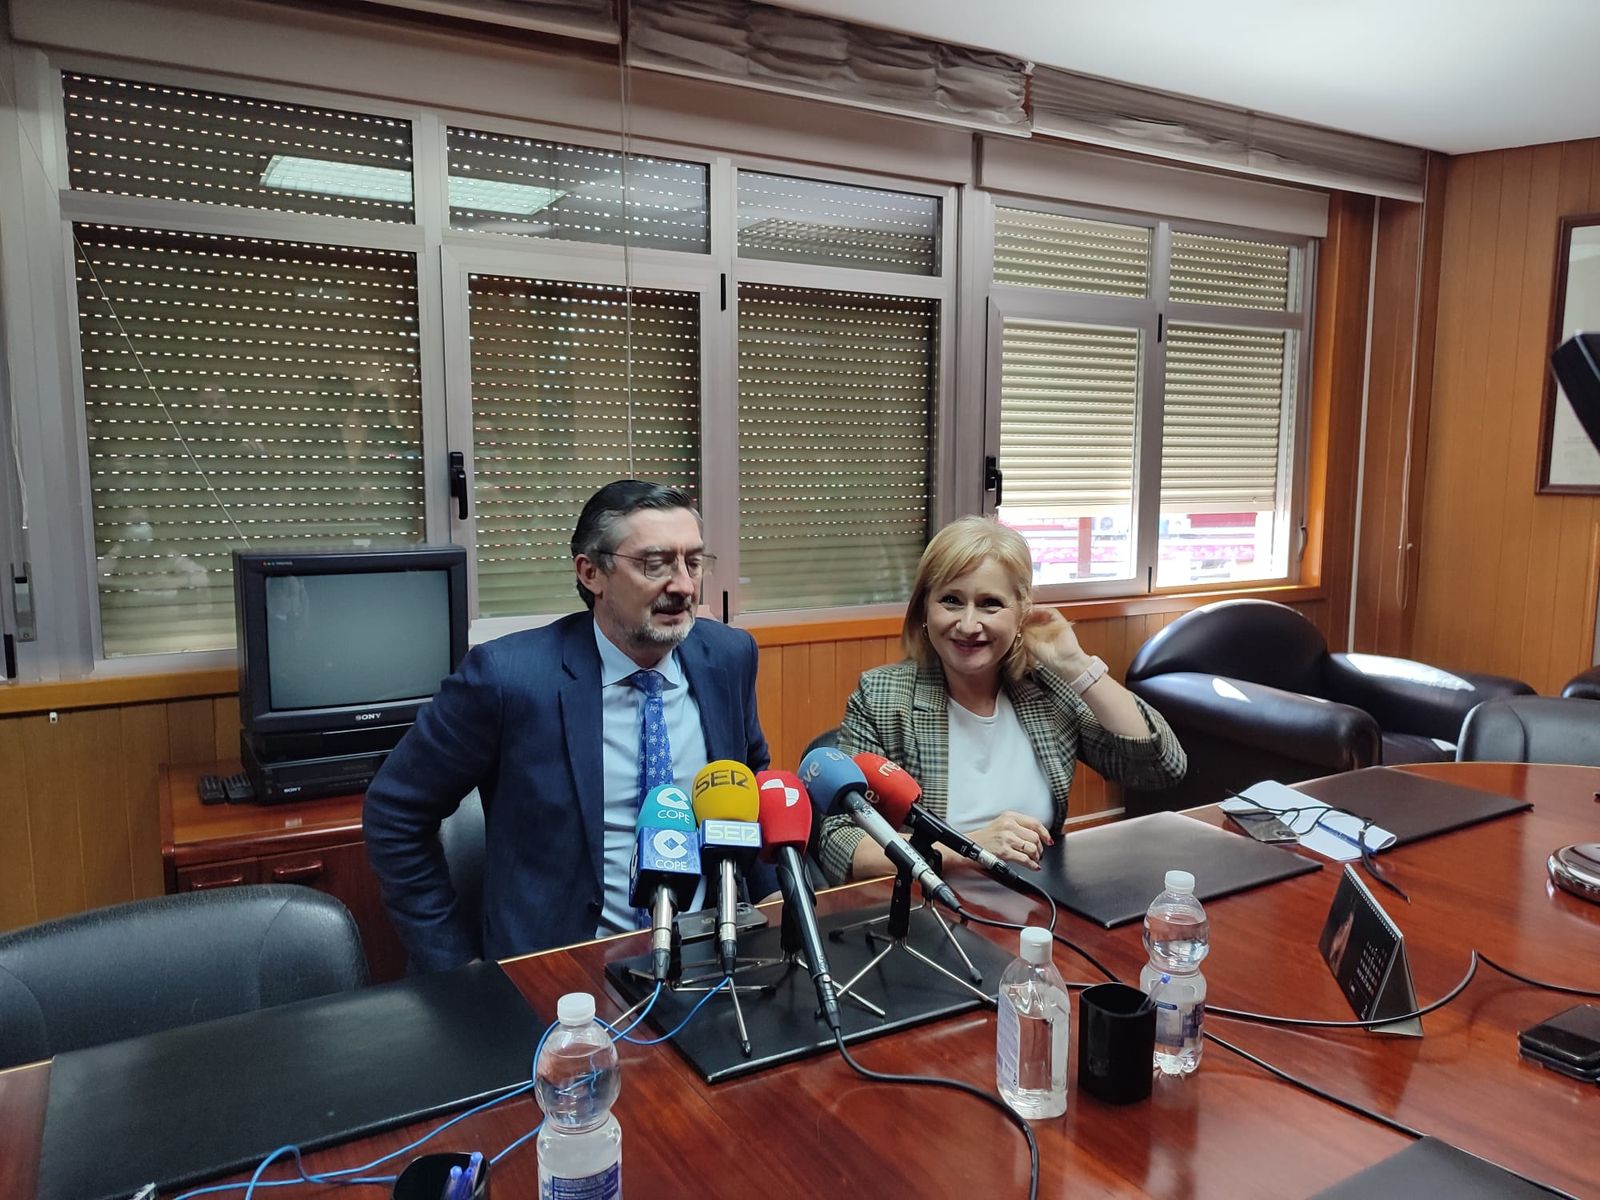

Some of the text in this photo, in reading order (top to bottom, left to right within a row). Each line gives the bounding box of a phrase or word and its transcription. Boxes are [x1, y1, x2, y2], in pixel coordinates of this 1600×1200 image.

[355, 712, 381, 721] SONY
[695, 769, 750, 798] SER
[657, 809, 691, 825] COPE
[707, 824, 757, 844] SER
[655, 860, 688, 870] COPE
